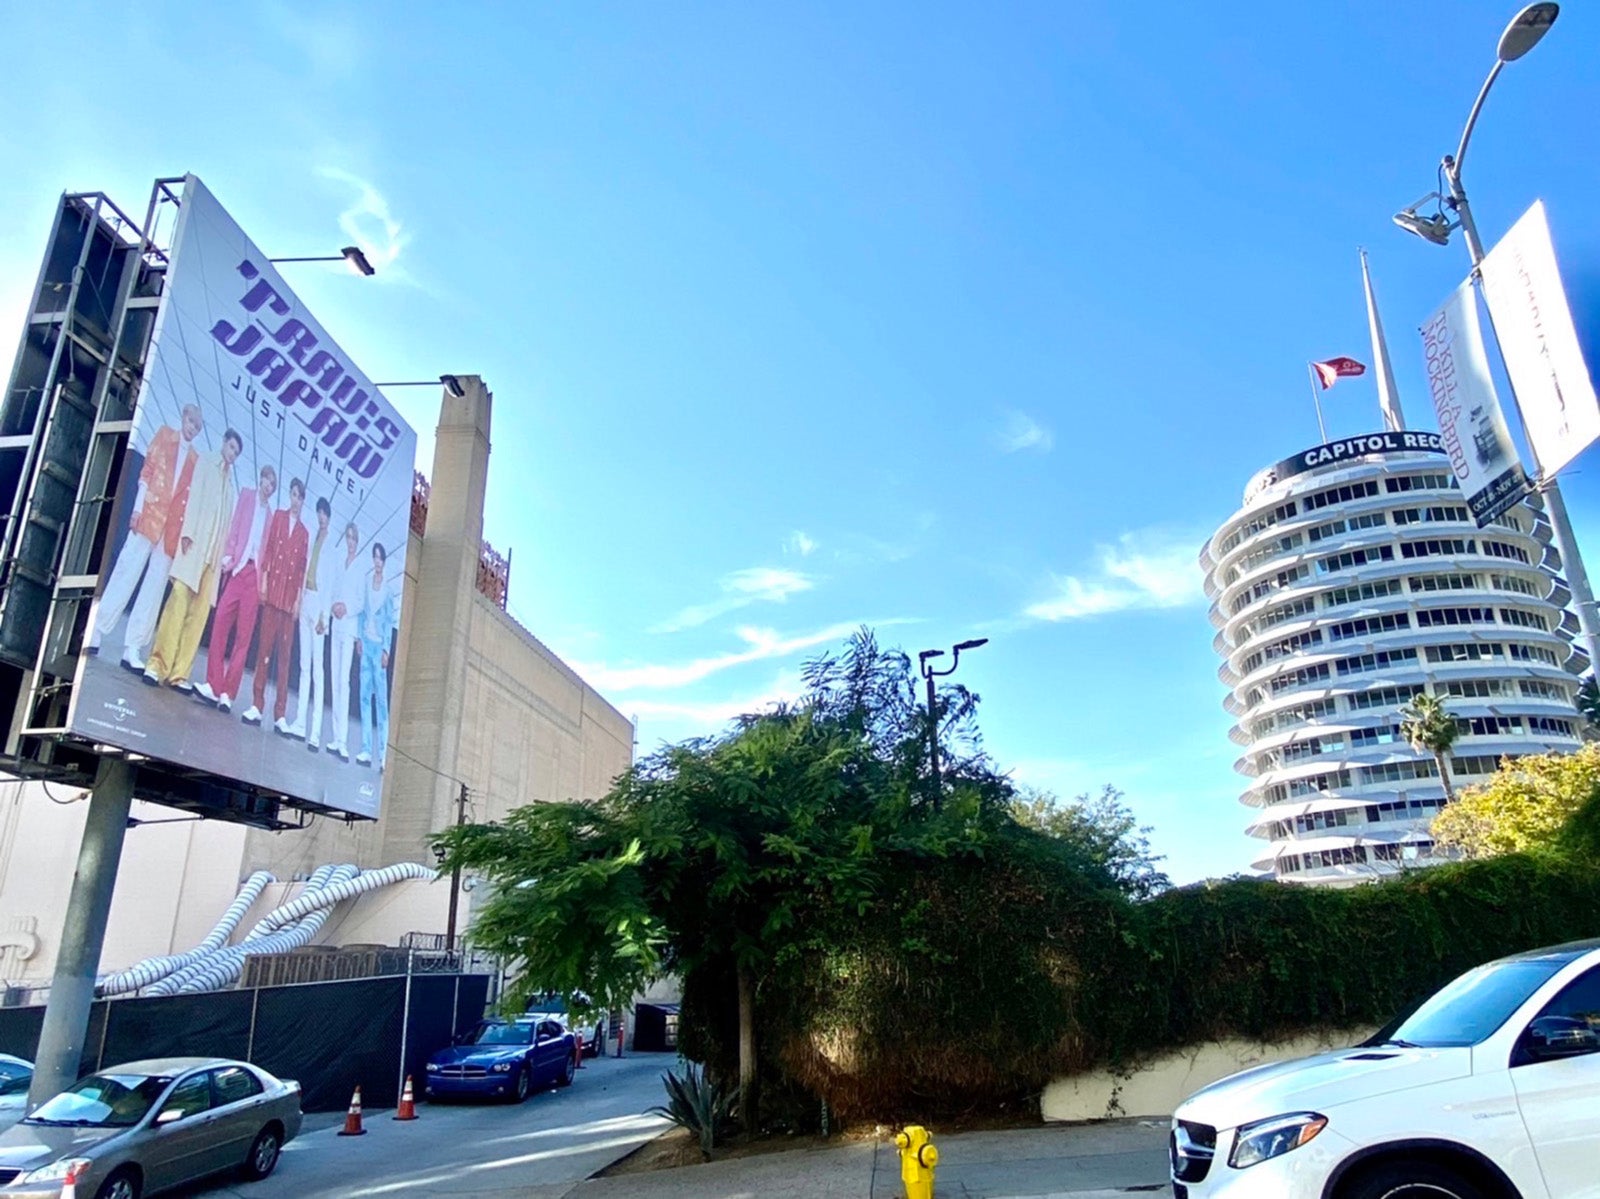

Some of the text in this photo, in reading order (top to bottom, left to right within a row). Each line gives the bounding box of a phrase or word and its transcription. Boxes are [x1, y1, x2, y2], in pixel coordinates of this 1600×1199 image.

[209, 319, 385, 479] JAPAN
[231, 375, 285, 429] JUST
[1423, 322, 1470, 481] MOCKINGBIRD
[1434, 310, 1462, 421] TO KILL A
[1304, 434, 1398, 466] CAPITOL
[1472, 496, 1488, 512] OCT
[1495, 478, 1511, 496] NOV
